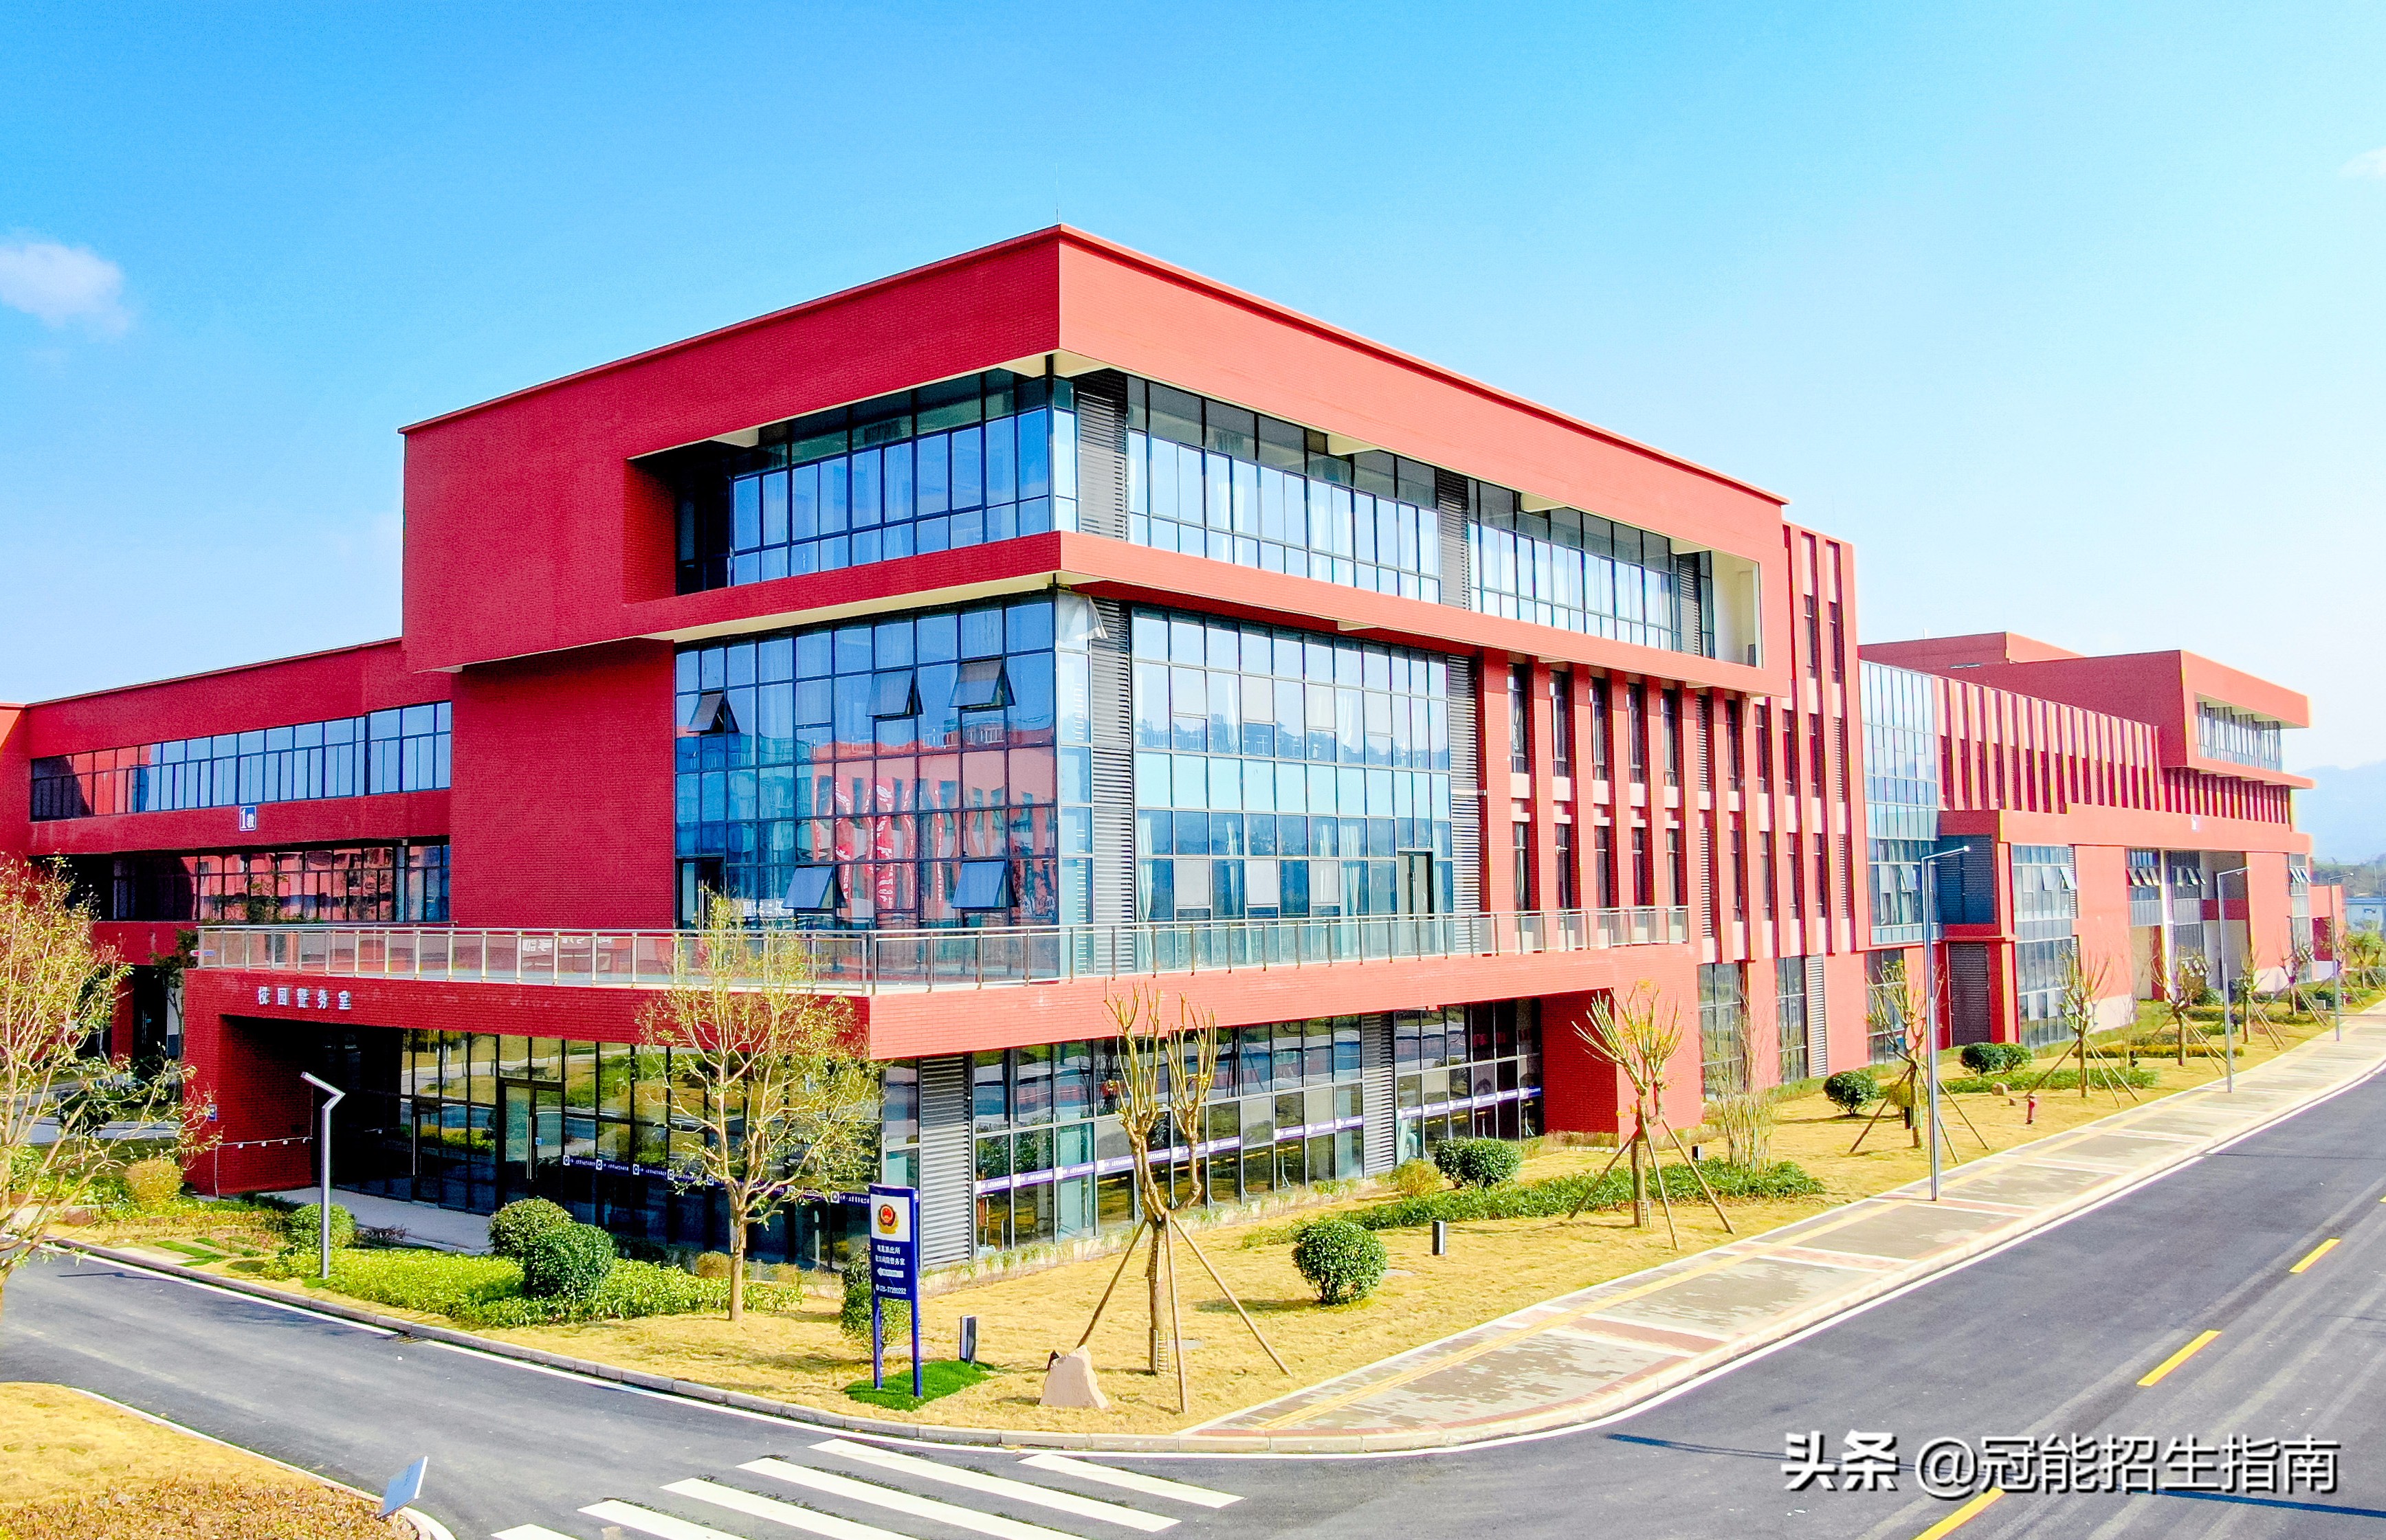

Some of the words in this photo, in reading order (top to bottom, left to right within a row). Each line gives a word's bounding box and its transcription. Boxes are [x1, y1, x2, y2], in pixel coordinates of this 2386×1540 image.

[258, 986, 353, 1010] 校园警务室
